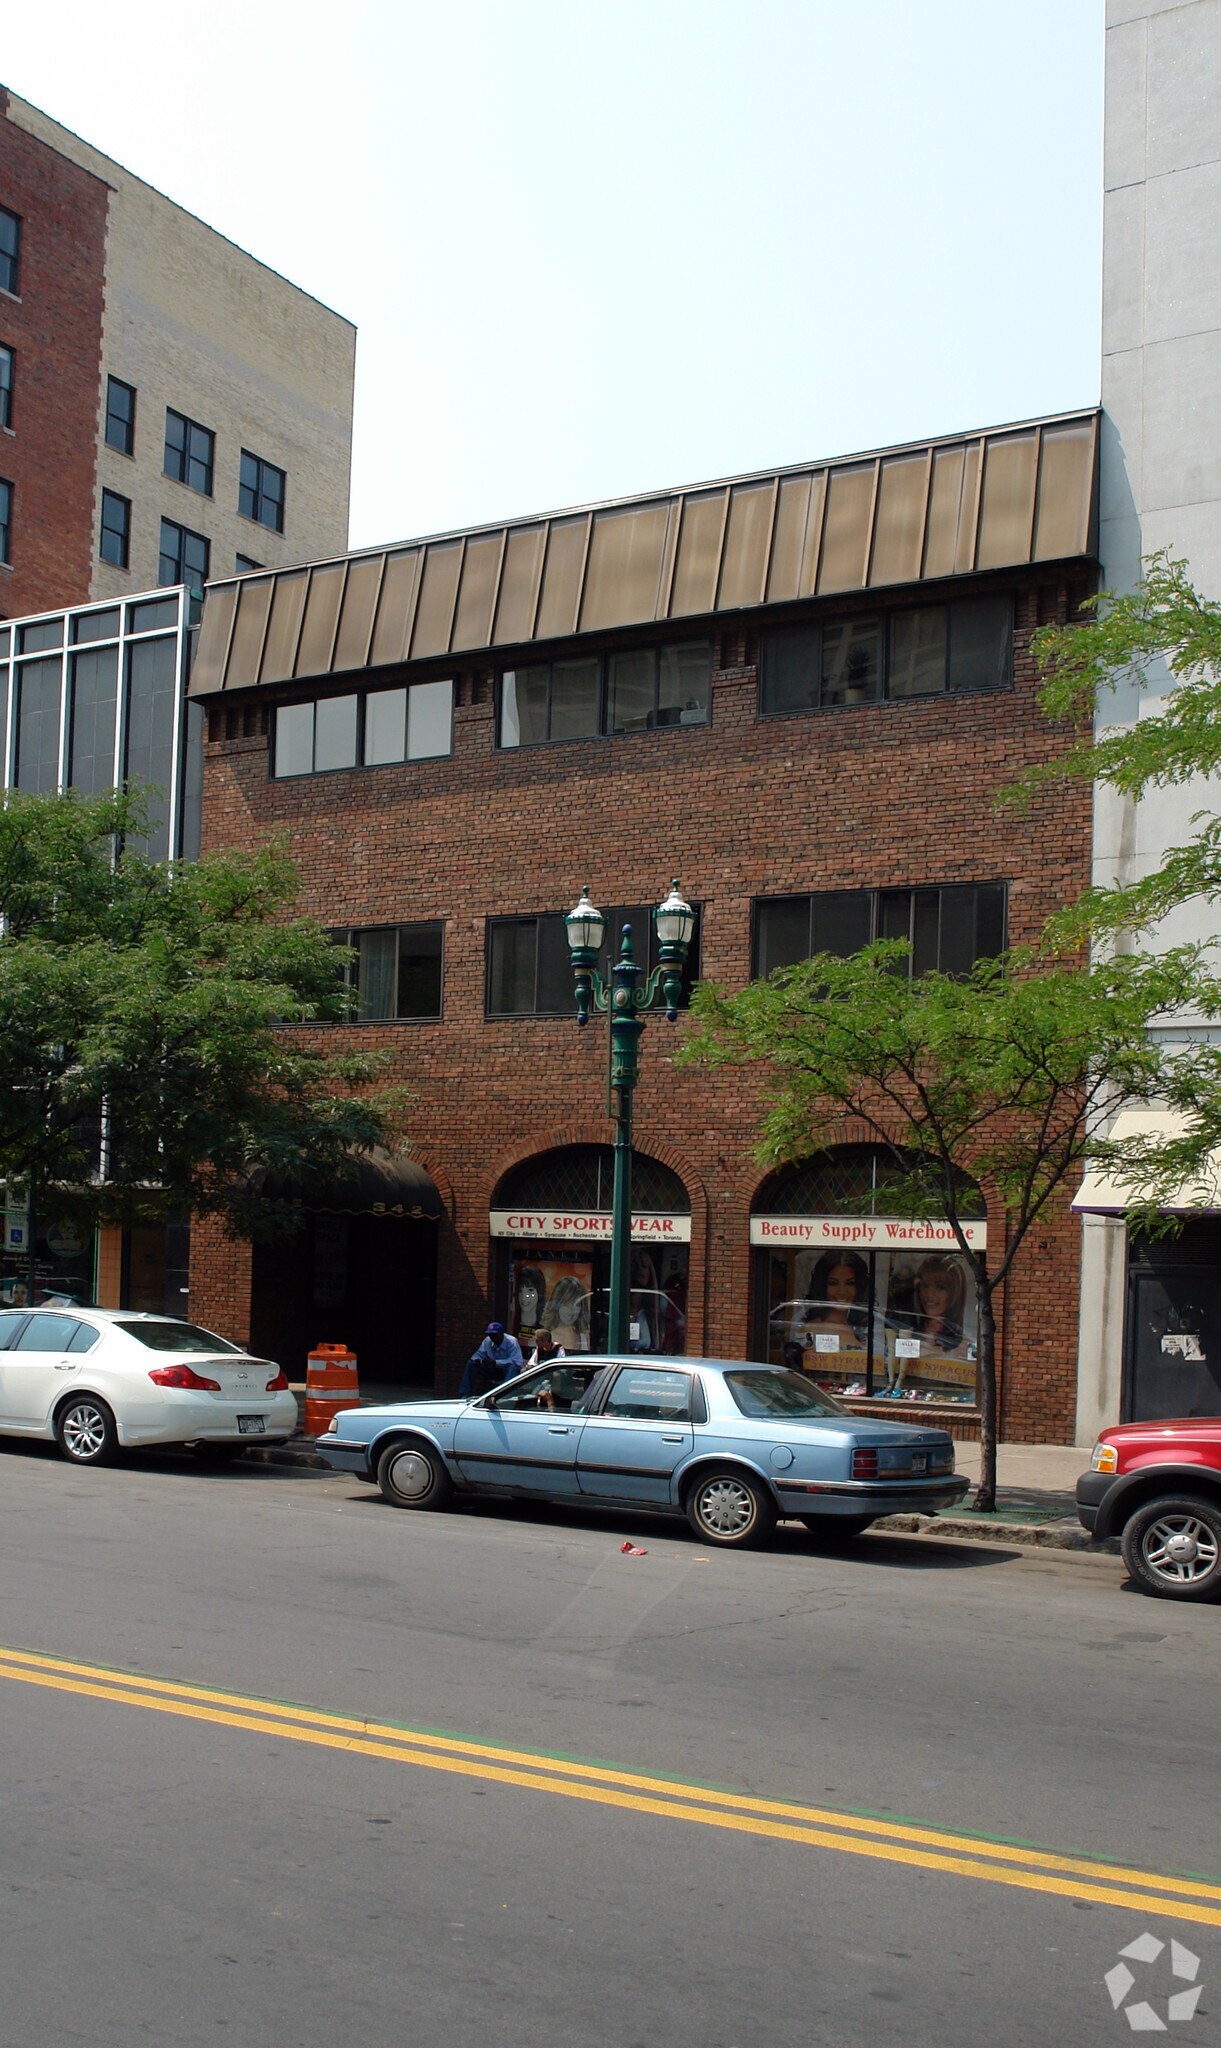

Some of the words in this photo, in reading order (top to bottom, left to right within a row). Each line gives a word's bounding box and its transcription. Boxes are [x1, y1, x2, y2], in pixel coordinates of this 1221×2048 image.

[372, 1202, 423, 1215] 342
[507, 1216, 547, 1229] CITY
[761, 1221, 813, 1240] Beauty
[822, 1222, 877, 1241] Supply
[885, 1223, 974, 1240] Warehoue
[831, 1356, 882, 1367] SYRACS
